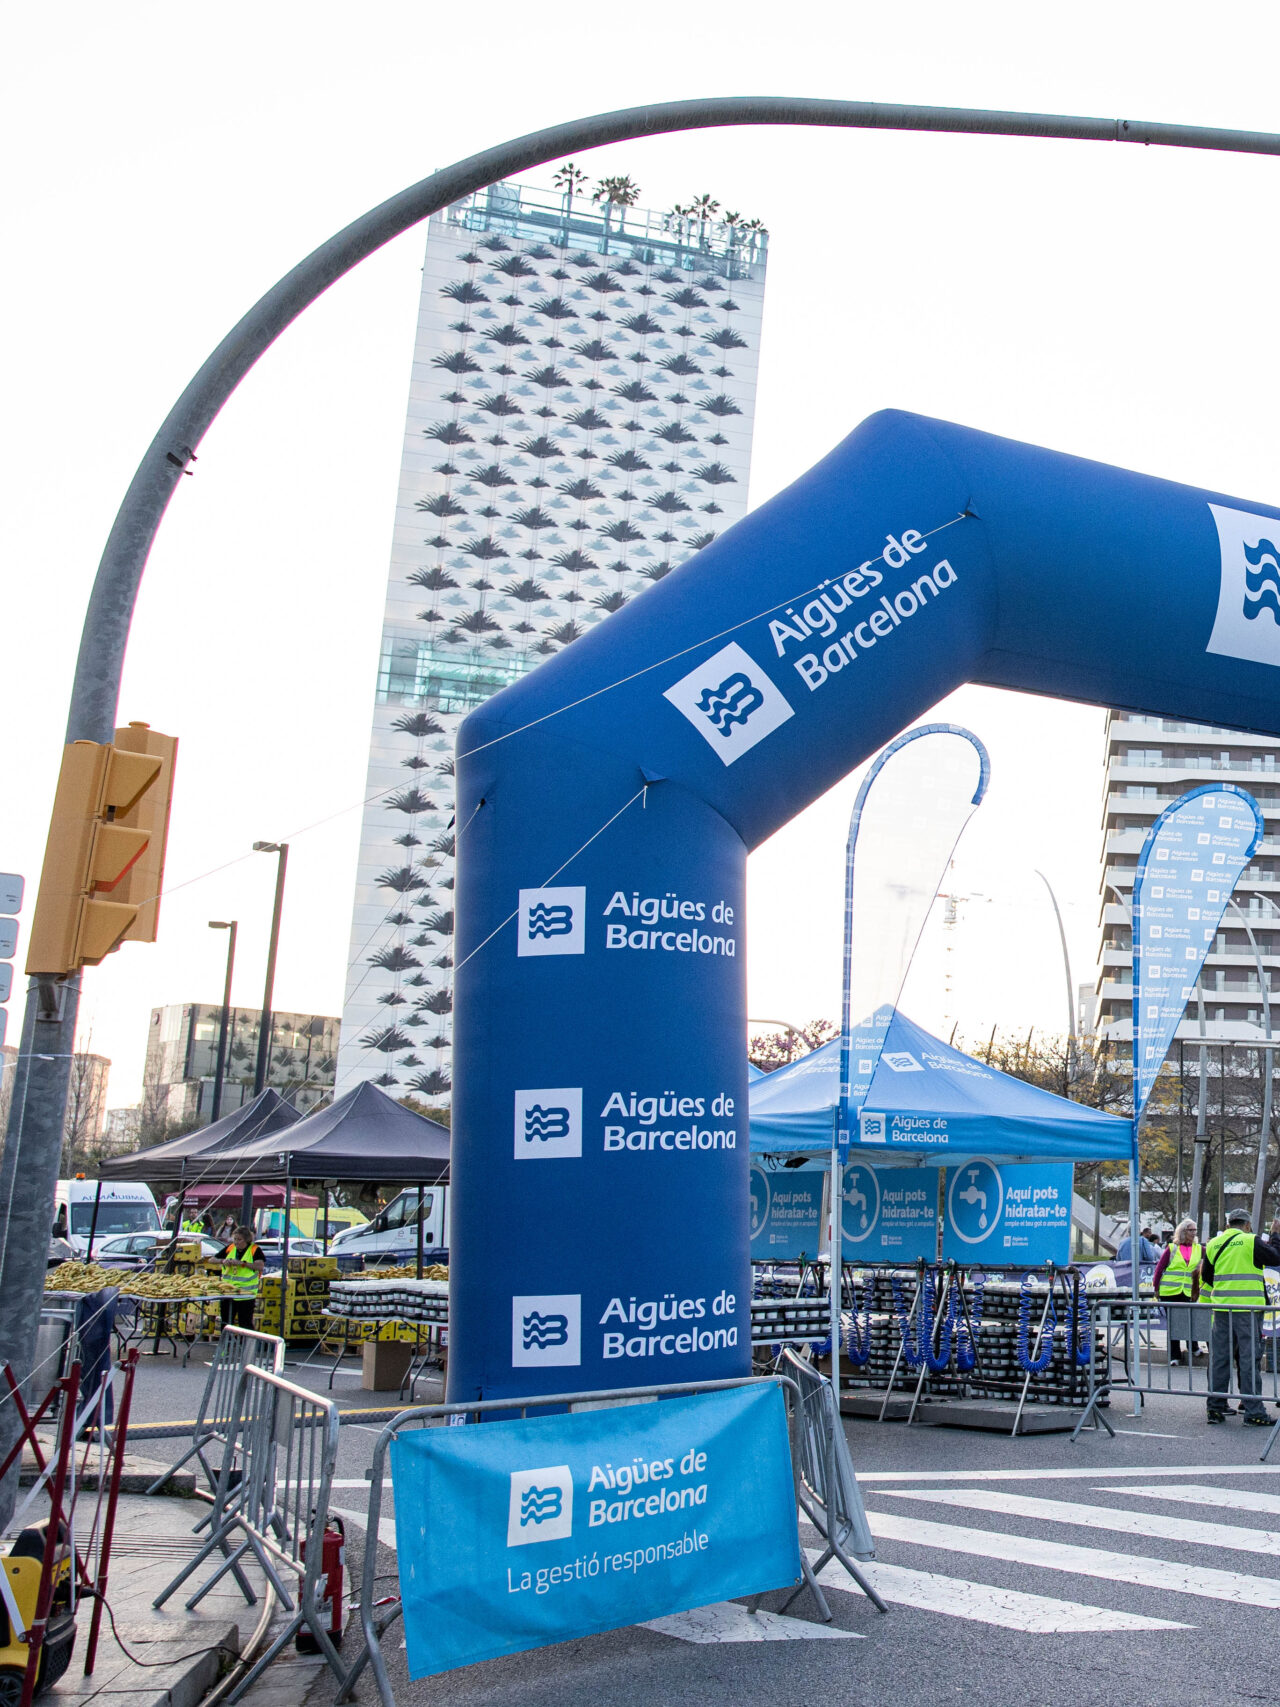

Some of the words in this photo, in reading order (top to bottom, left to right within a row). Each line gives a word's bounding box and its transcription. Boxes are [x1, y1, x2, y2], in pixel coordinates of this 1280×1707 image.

[768, 560, 883, 658] Aigües
[882, 528, 928, 569] de
[793, 559, 958, 692] Barcelona
[602, 891, 706, 924] Aigües
[712, 900, 734, 926] de
[606, 924, 736, 957] Barcelona
[600, 1090, 705, 1124] Aigües
[711, 1092, 735, 1117] de
[891, 1115, 930, 1130] Aigües
[932, 1118, 948, 1129] de
[604, 1125, 736, 1150] Barcelona
[892, 1130, 949, 1143] Barcelona
[772, 1191, 792, 1206] Aquí
[793, 1192, 812, 1205] pots
[882, 1188, 903, 1204] Aquí
[904, 1189, 927, 1204] pots
[1006, 1186, 1031, 1202] Aquí
[1033, 1186, 1058, 1202] pots
[771, 1206, 818, 1219] hidratar-te
[882, 1206, 934, 1218] hidratar-te
[1005, 1204, 1067, 1218] hidratar-te
[599, 1293, 706, 1330] Aigües
[712, 1290, 736, 1316] de
[602, 1326, 738, 1359] Barcelona
[587, 1457, 674, 1496] Aigües
[680, 1448, 708, 1475] de
[588, 1484, 708, 1528] Barcelona
[508, 1568, 531, 1594] La
[535, 1552, 600, 1595] gestió
[604, 1528, 710, 1574] responsable
